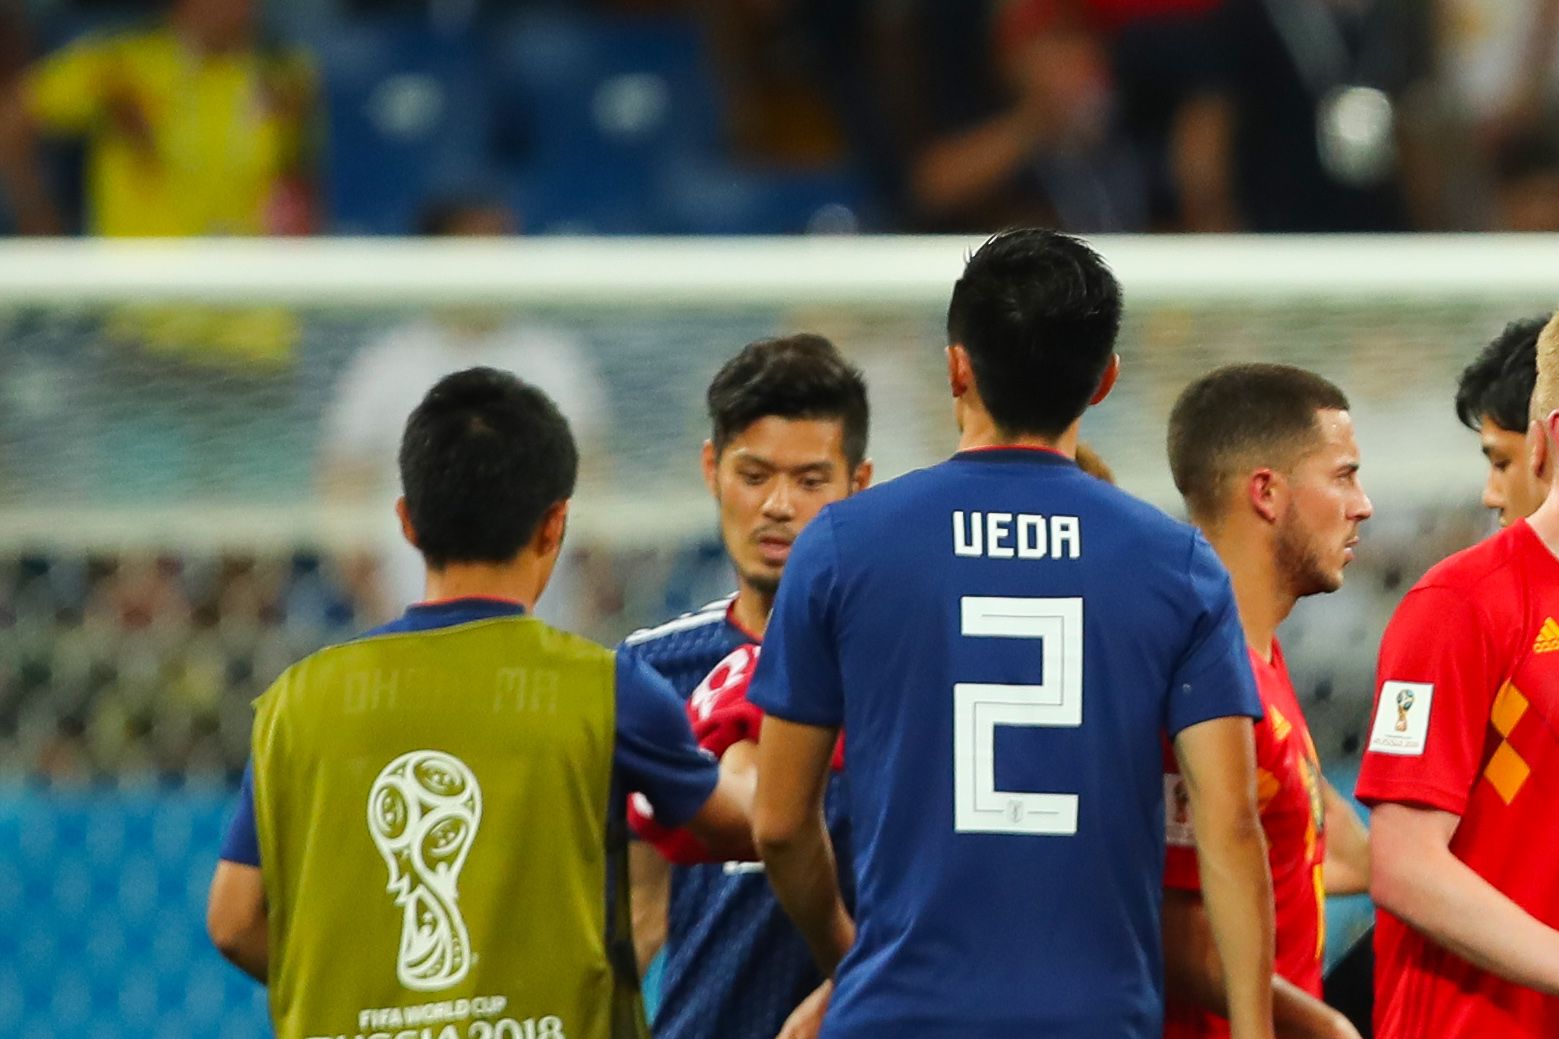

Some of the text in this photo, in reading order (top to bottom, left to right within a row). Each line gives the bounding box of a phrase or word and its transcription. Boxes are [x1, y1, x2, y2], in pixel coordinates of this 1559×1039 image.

[952, 510, 1081, 559] UEDA
[953, 596, 1083, 835] 2
[471, 995, 509, 1017] CUP
